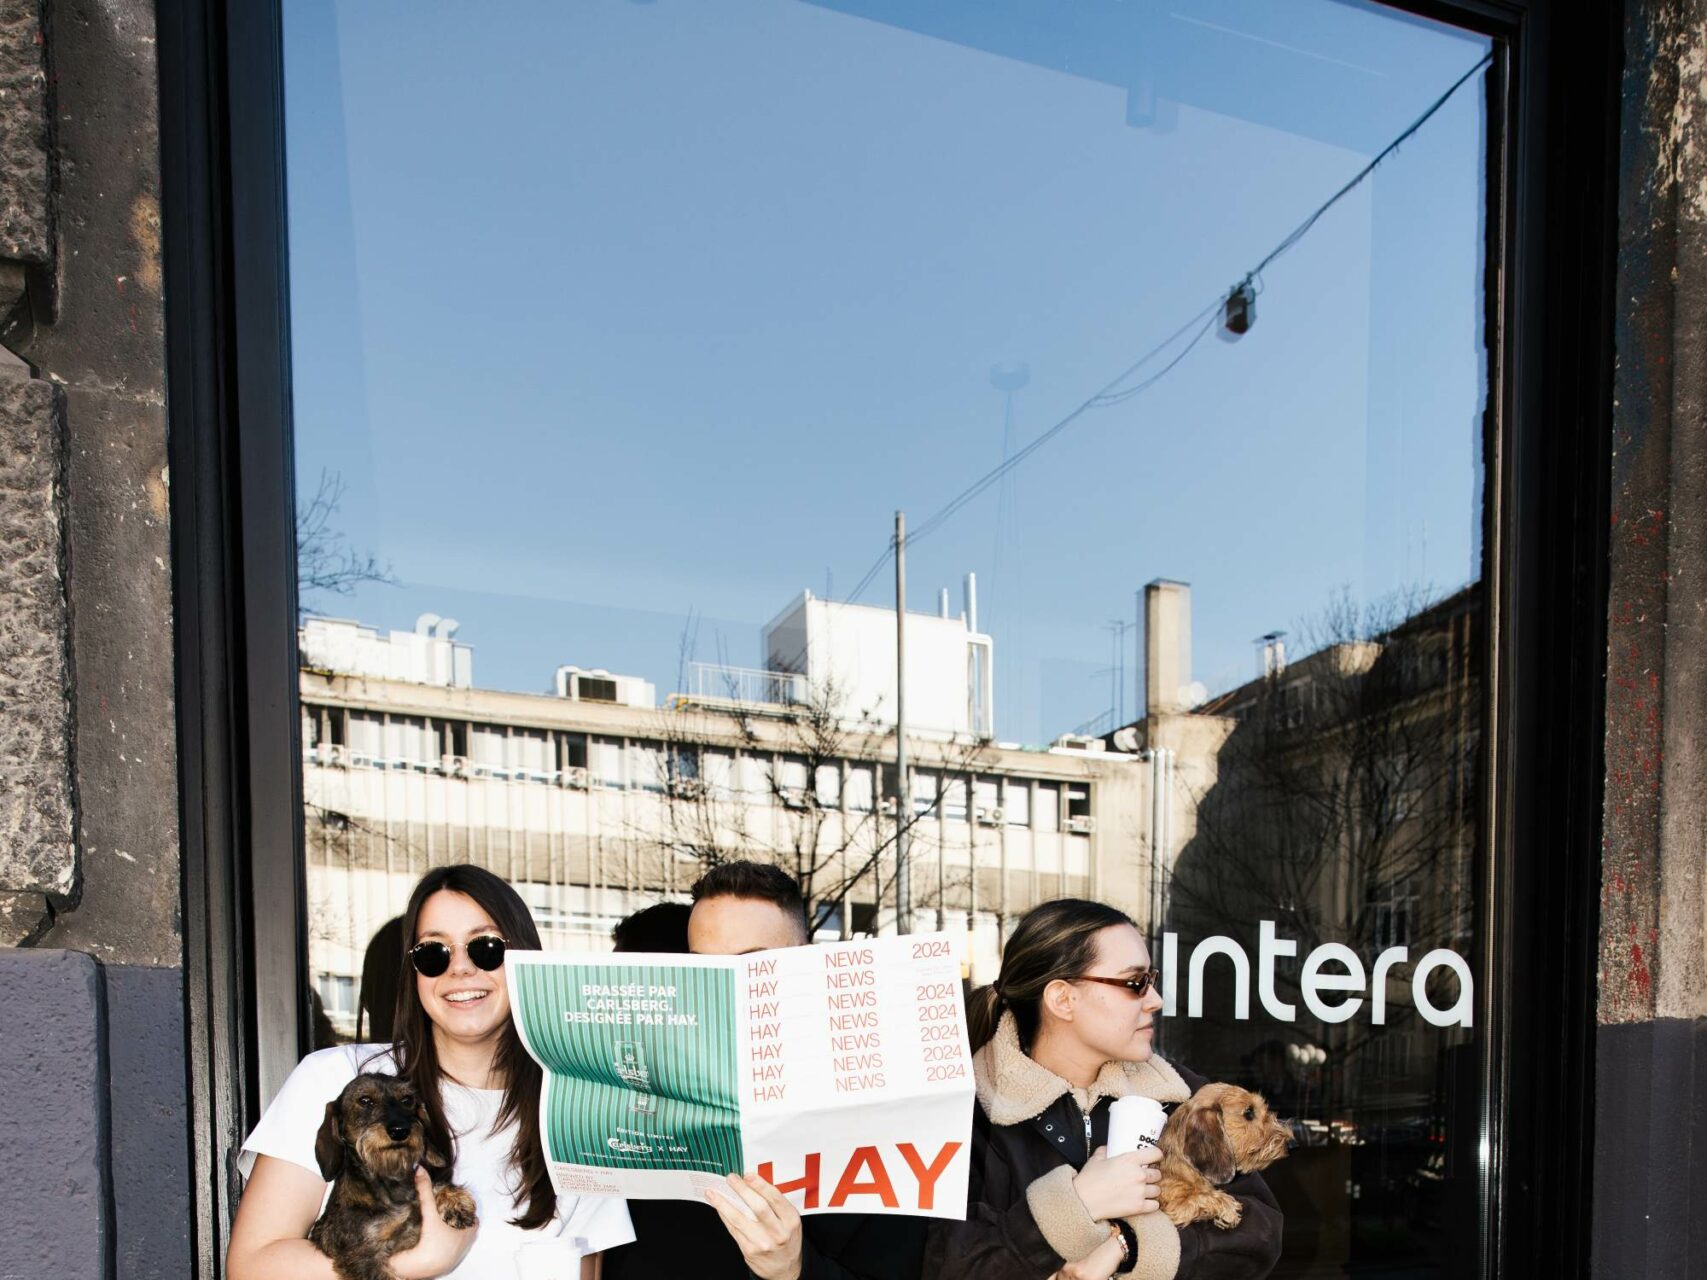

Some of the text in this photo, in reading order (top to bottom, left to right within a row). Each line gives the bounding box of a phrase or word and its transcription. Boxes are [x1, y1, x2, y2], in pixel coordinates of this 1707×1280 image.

[748, 940, 951, 979] HAY NEWS 2024
[582, 983, 676, 997] BRASSÉE PAR
[749, 970, 875, 999] HAY NEWS
[750, 983, 955, 1020] HAY NEWS 2024
[564, 1010, 698, 1025] DESIGNÉE PAR HAY.
[587, 999, 673, 1011] CARLSBERG.
[751, 1003, 957, 1041] HAY NEWS 2024
[752, 1023, 960, 1062] HAY NEWS 2024
[753, 1044, 962, 1083] HAY NEWS 2024
[754, 1063, 965, 1103] HAY NEWS 2024
[608, 1138, 653, 1154] Carlsberg
[758, 1142, 963, 1210] HAY
